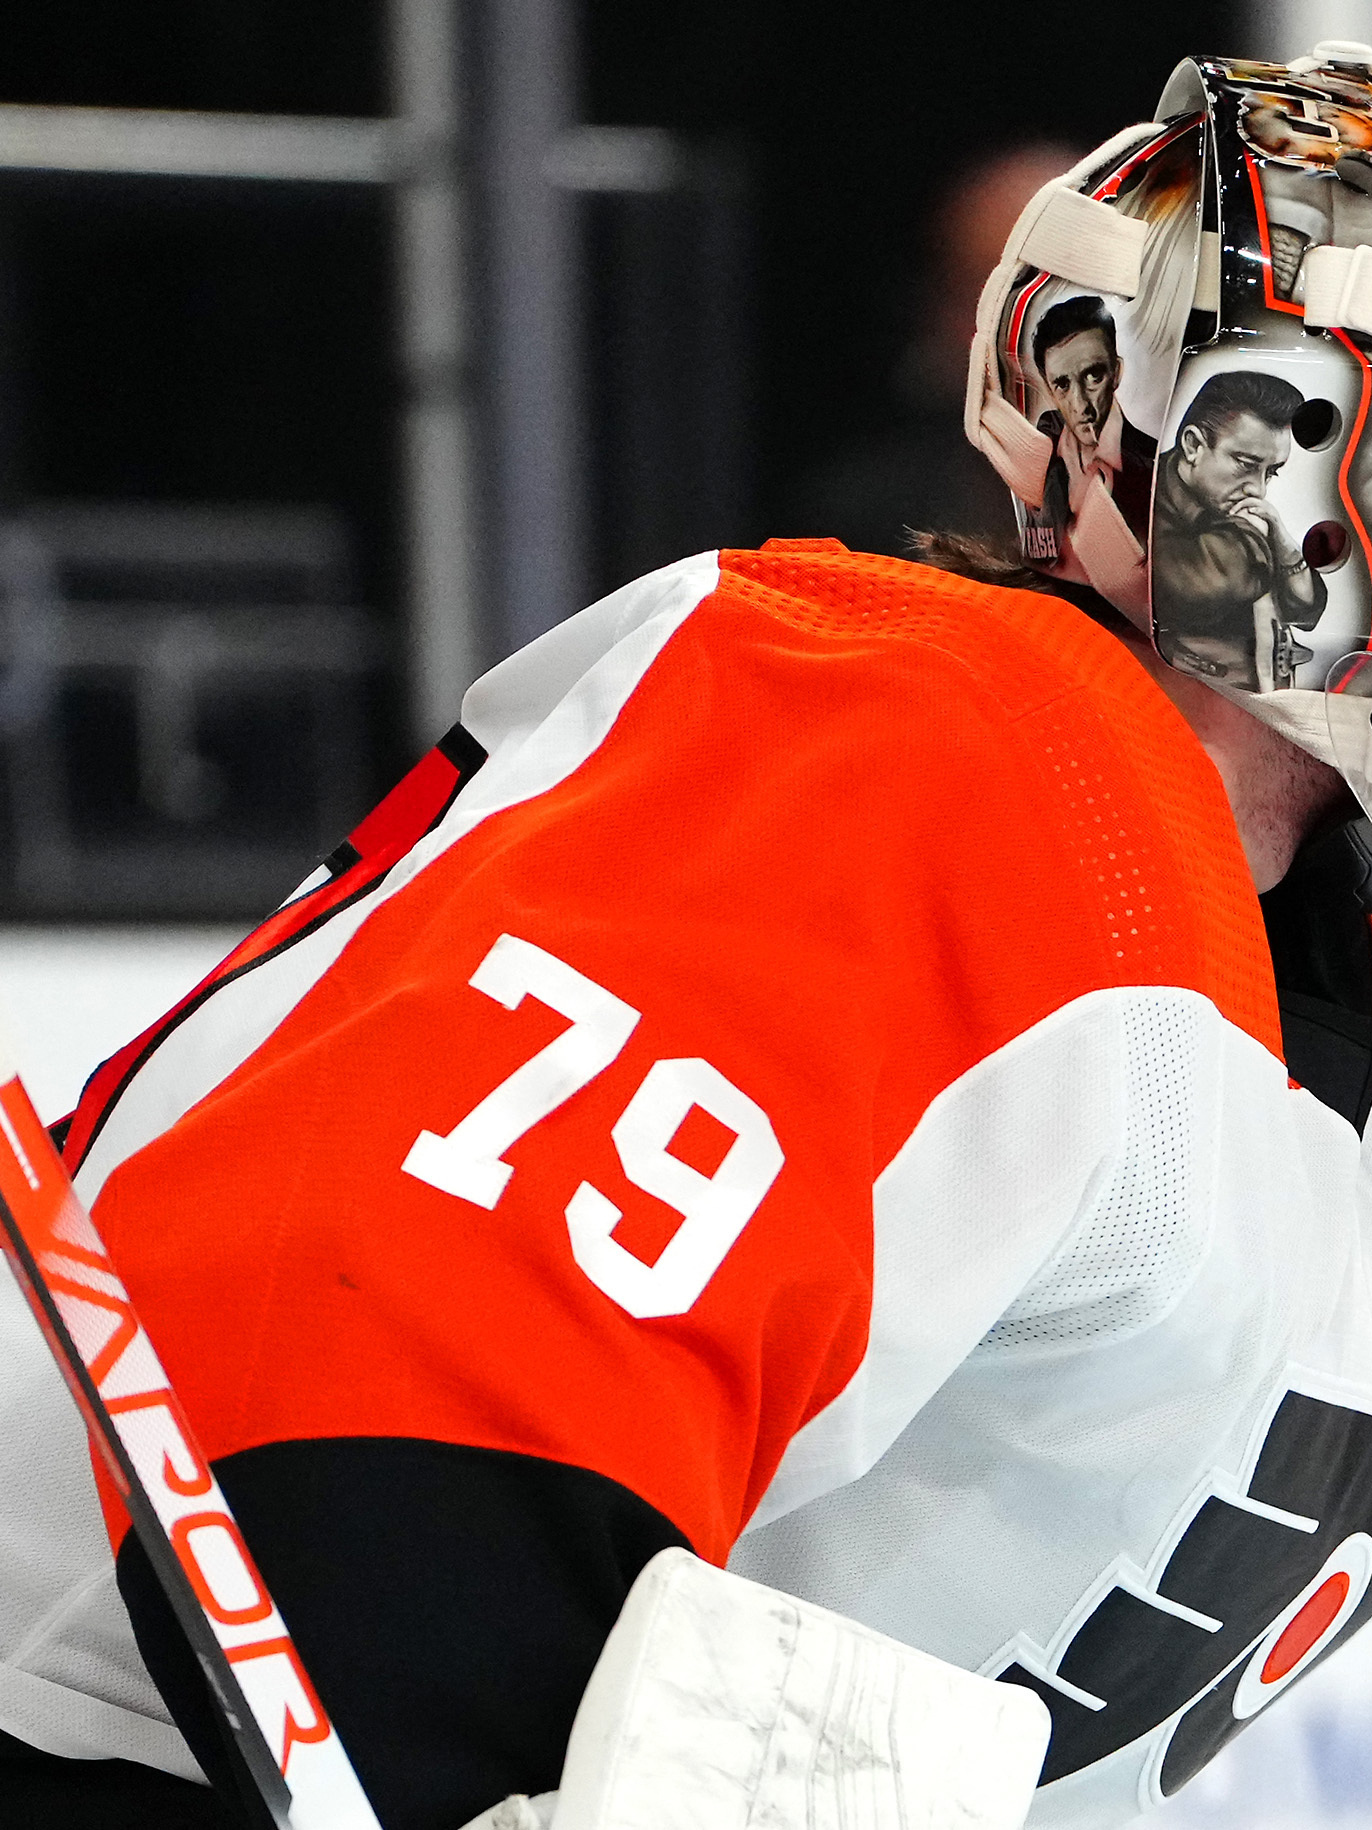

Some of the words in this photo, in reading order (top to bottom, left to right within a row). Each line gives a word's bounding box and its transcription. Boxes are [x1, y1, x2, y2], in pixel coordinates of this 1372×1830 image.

[1026, 526, 1059, 559] CASH
[402, 932, 785, 1318] 79
[37, 1212, 332, 1776] VAPOR
